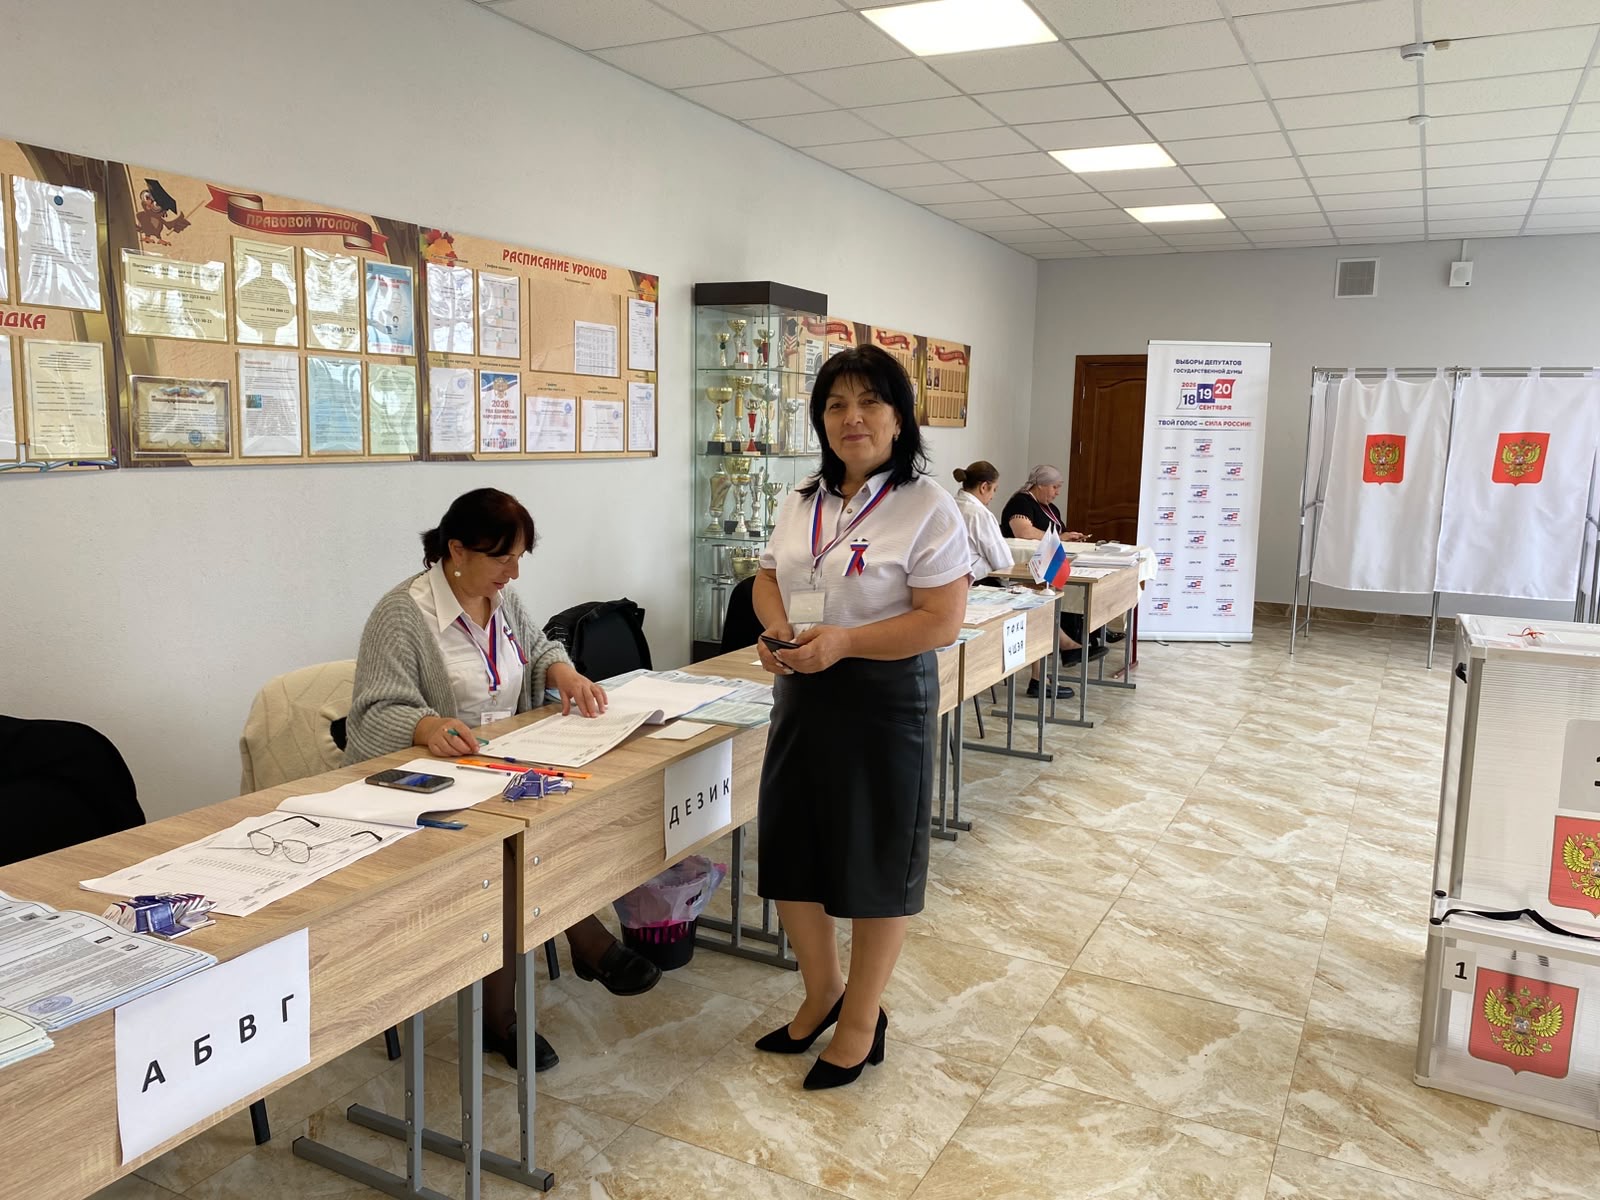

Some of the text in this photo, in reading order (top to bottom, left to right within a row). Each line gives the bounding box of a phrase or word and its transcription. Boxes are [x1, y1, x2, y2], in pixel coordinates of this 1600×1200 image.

[246, 213, 359, 233] ПРАВОВОЙ УГОЛОК
[502, 248, 608, 280] РАСПИСАНИЕ УРОКОВ
[1182, 383, 1231, 405] 18 19 20
[669, 777, 730, 829] Д Е З И К
[1454, 961, 1467, 980] 1
[142, 993, 294, 1093] А Б В Г
